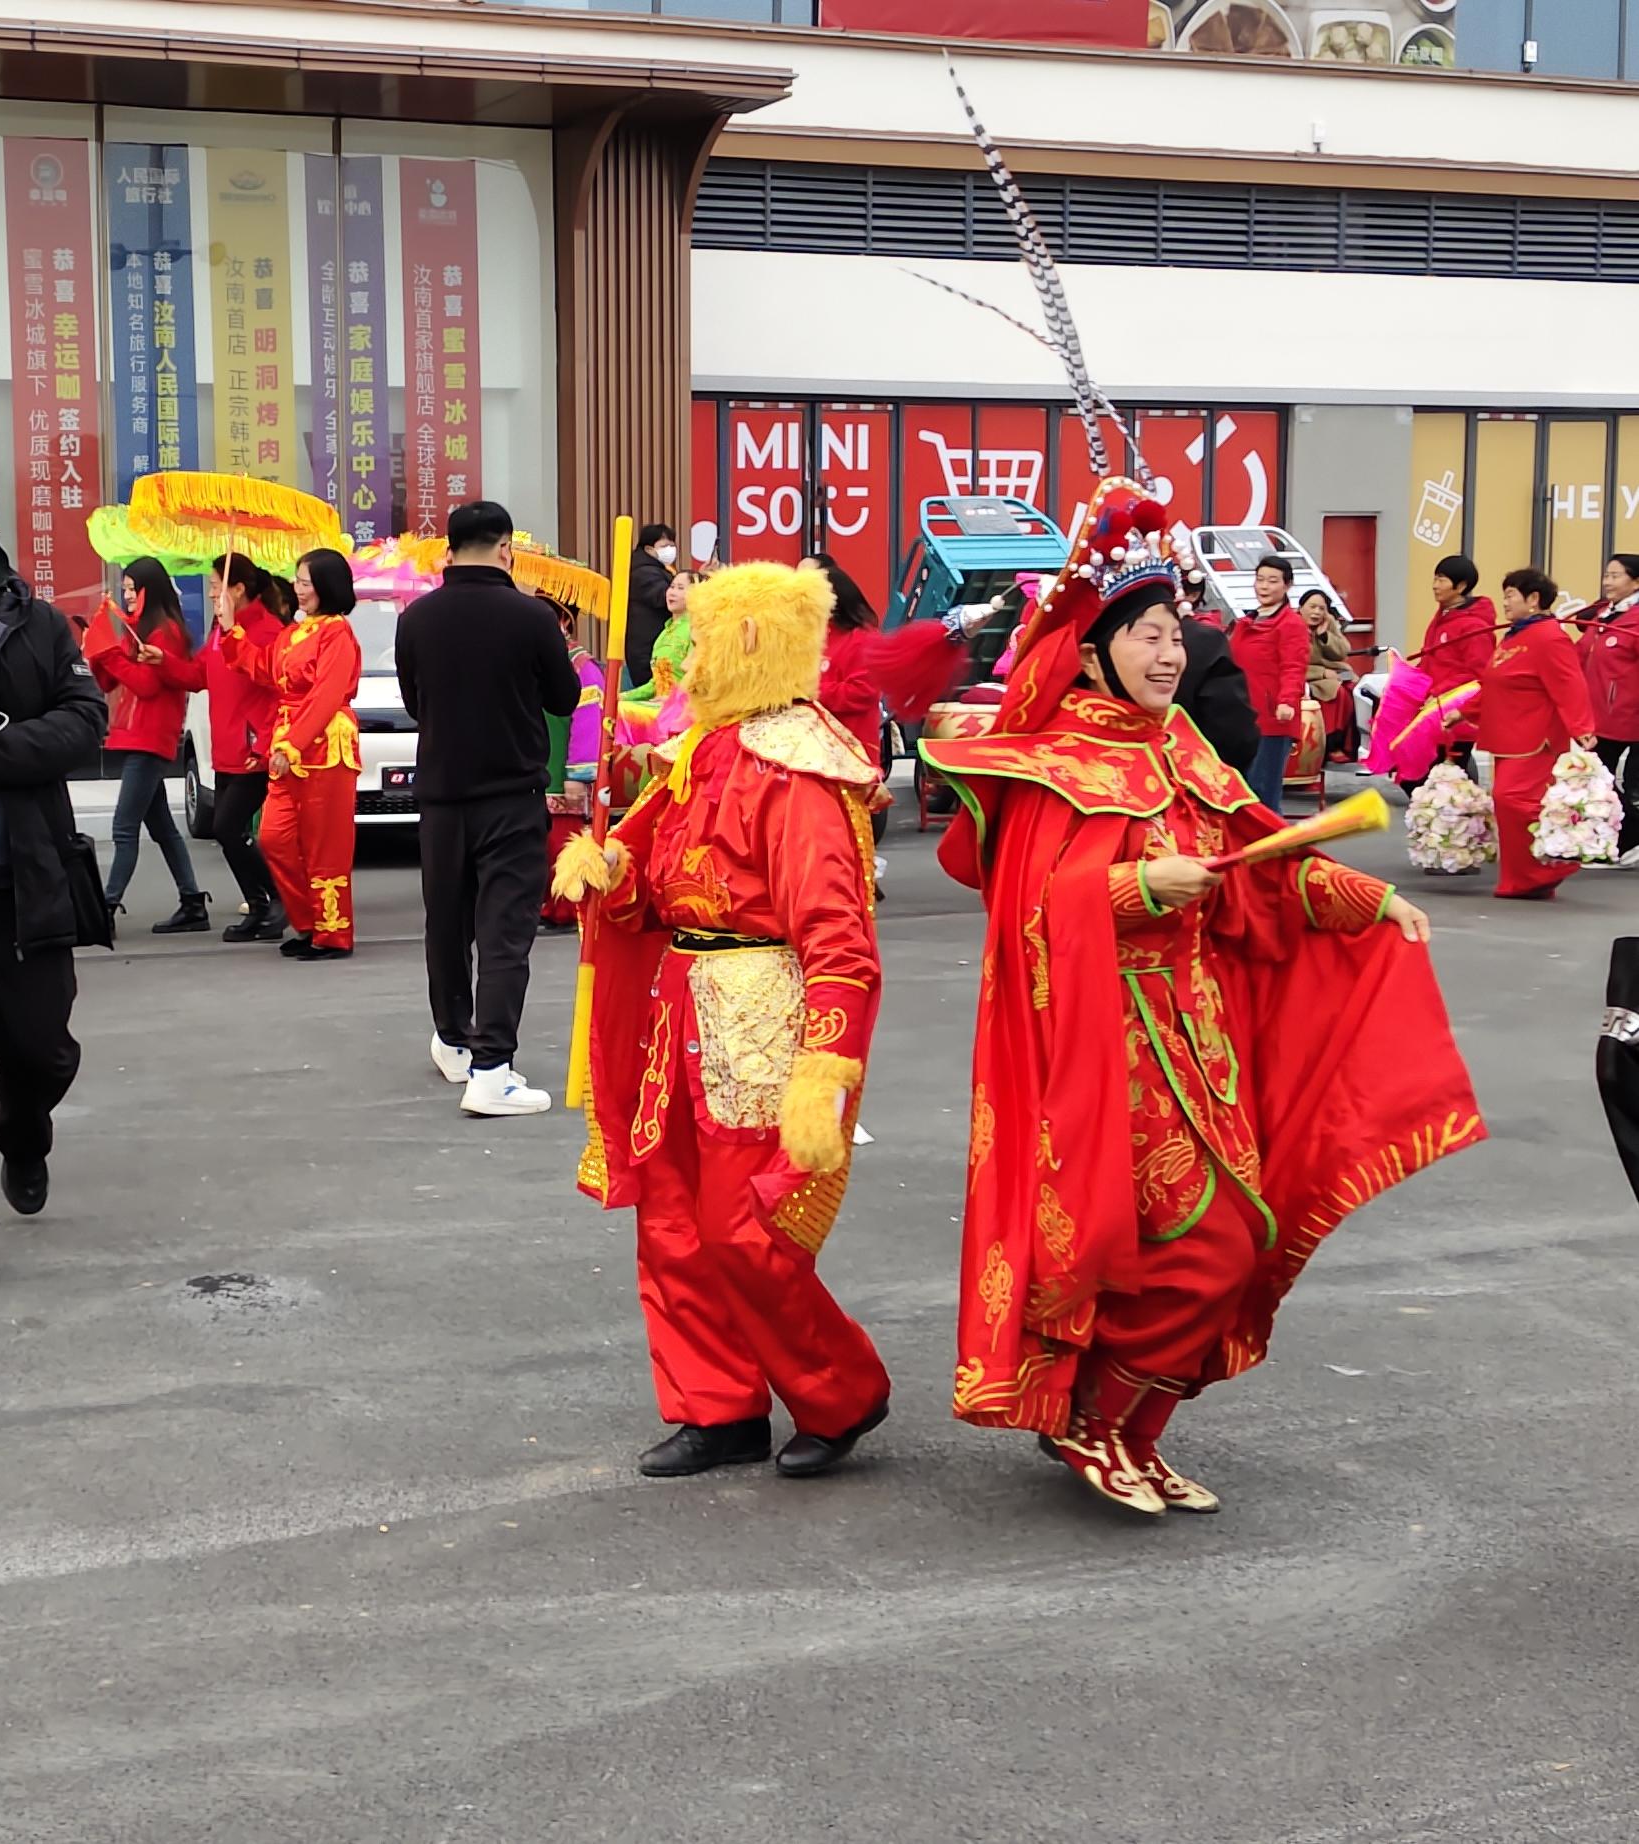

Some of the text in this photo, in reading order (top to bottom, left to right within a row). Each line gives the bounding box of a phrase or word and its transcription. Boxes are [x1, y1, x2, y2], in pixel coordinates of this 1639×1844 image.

[52, 248, 83, 509] 恭喜幸运咖签约入驻
[125, 252, 148, 435] 本地知名旅行服务商
[224, 256, 247, 357] 汝南首店
[413, 263, 435, 417] 汝南首家旗舰店
[22, 248, 54, 603] 蜜雪冰城旗下 优质现磨咖啡品牌
[736, 422, 870, 470] MINI
